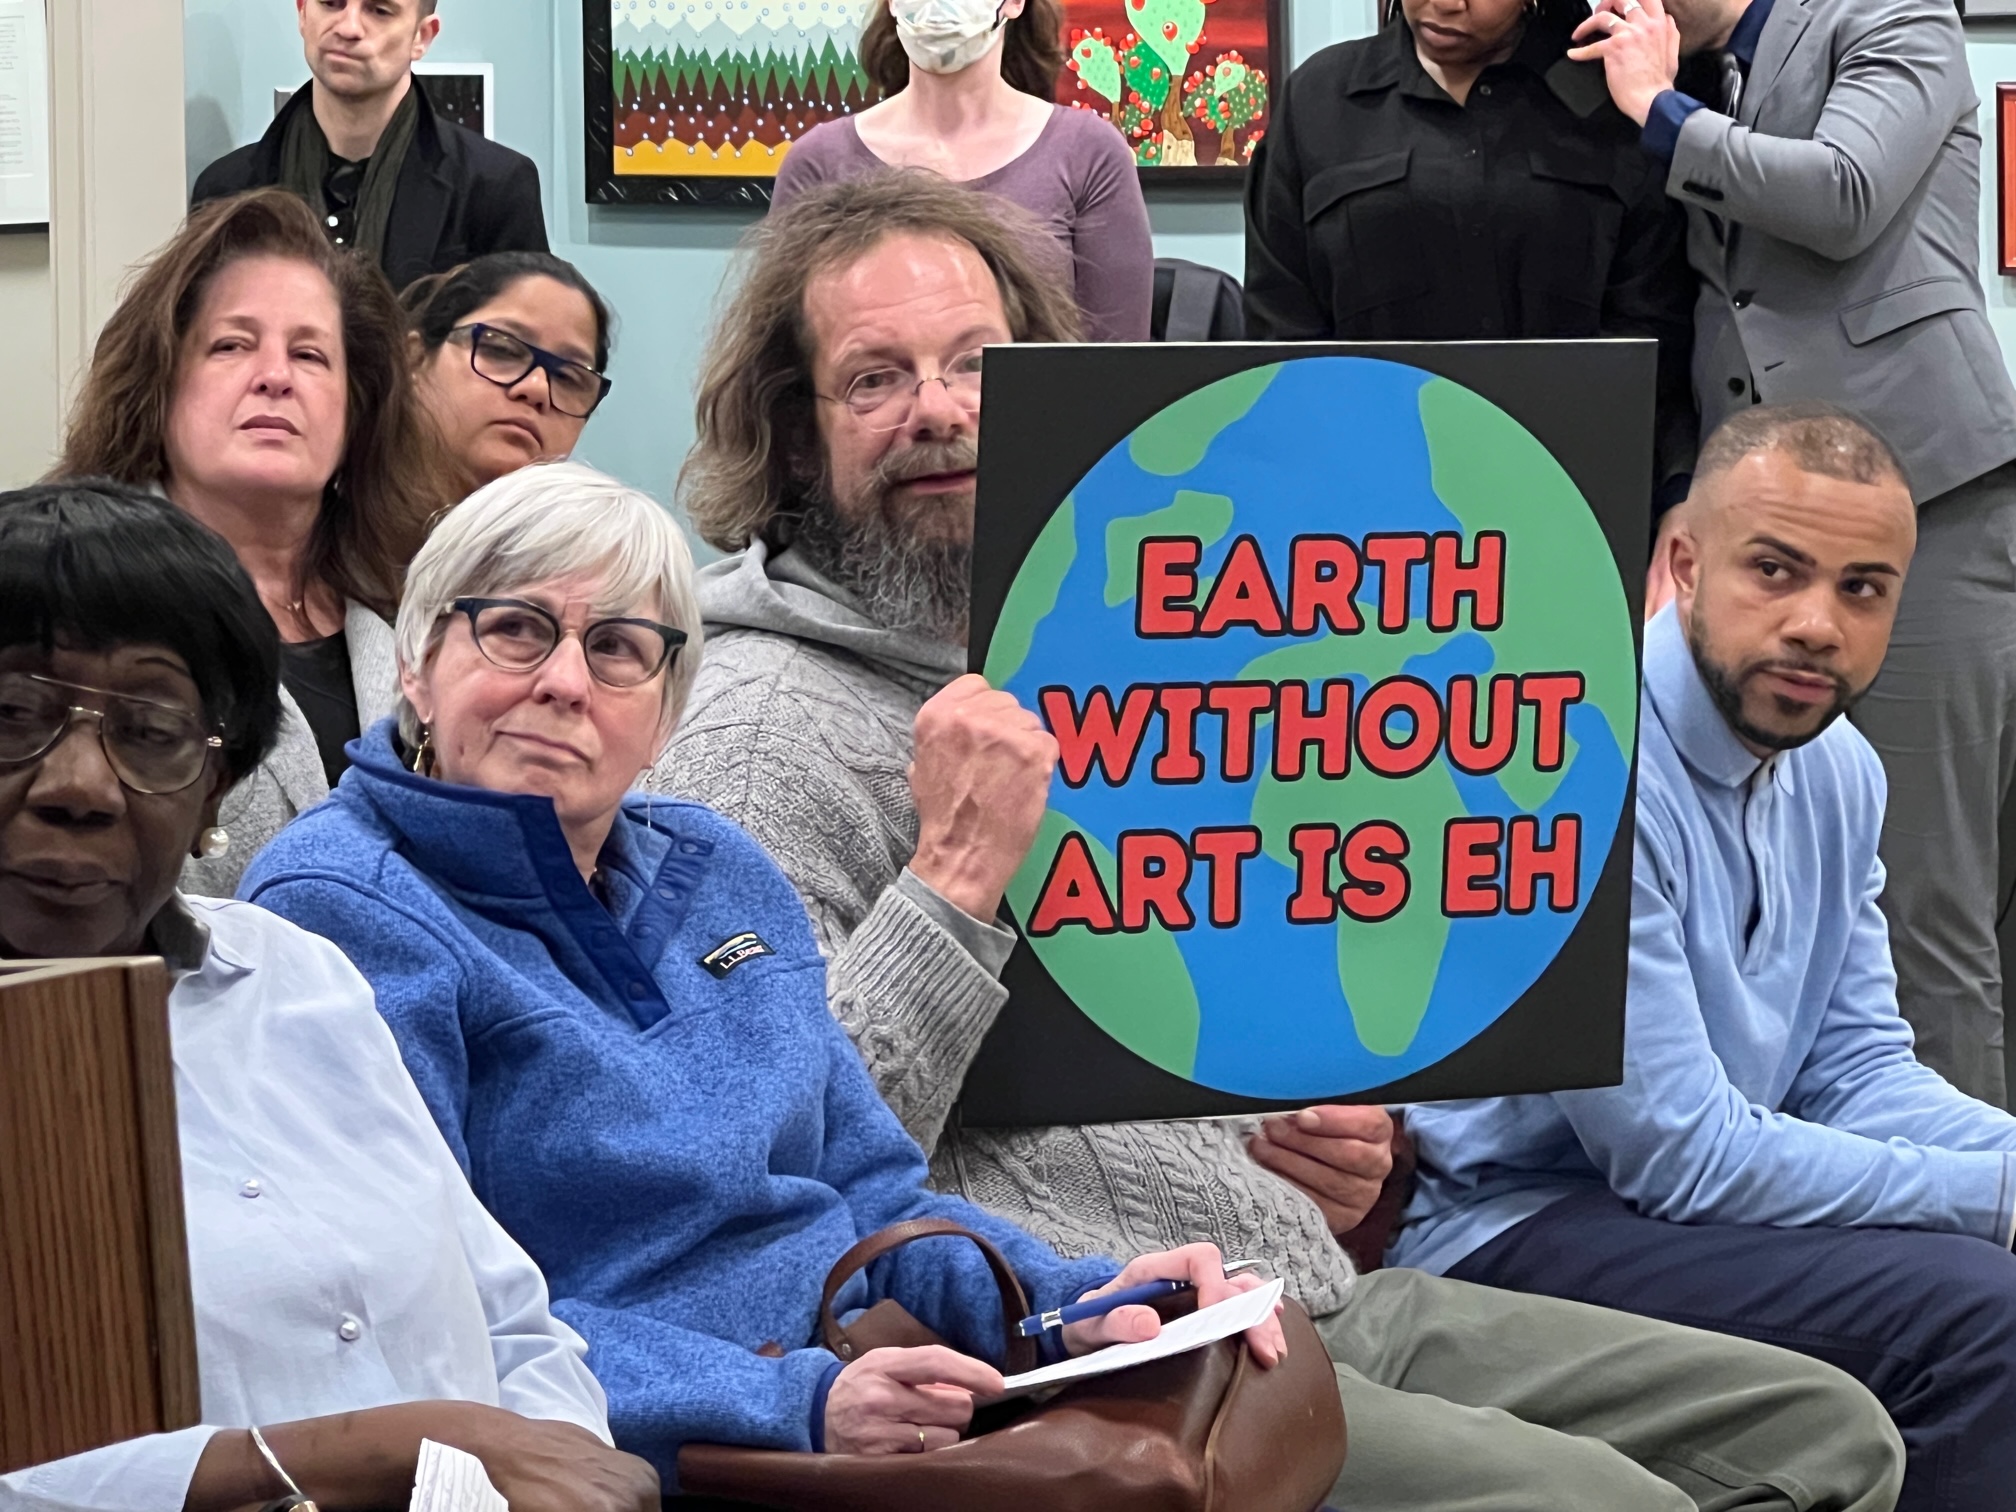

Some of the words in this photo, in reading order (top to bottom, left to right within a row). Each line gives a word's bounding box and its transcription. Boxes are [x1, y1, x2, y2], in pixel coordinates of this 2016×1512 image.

[1136, 530, 1506, 639] EARTH
[1041, 671, 1584, 788] WITHOUT
[1026, 826, 1261, 938] ART
[1286, 820, 1411, 924] IS
[1440, 814, 1582, 917] EH
